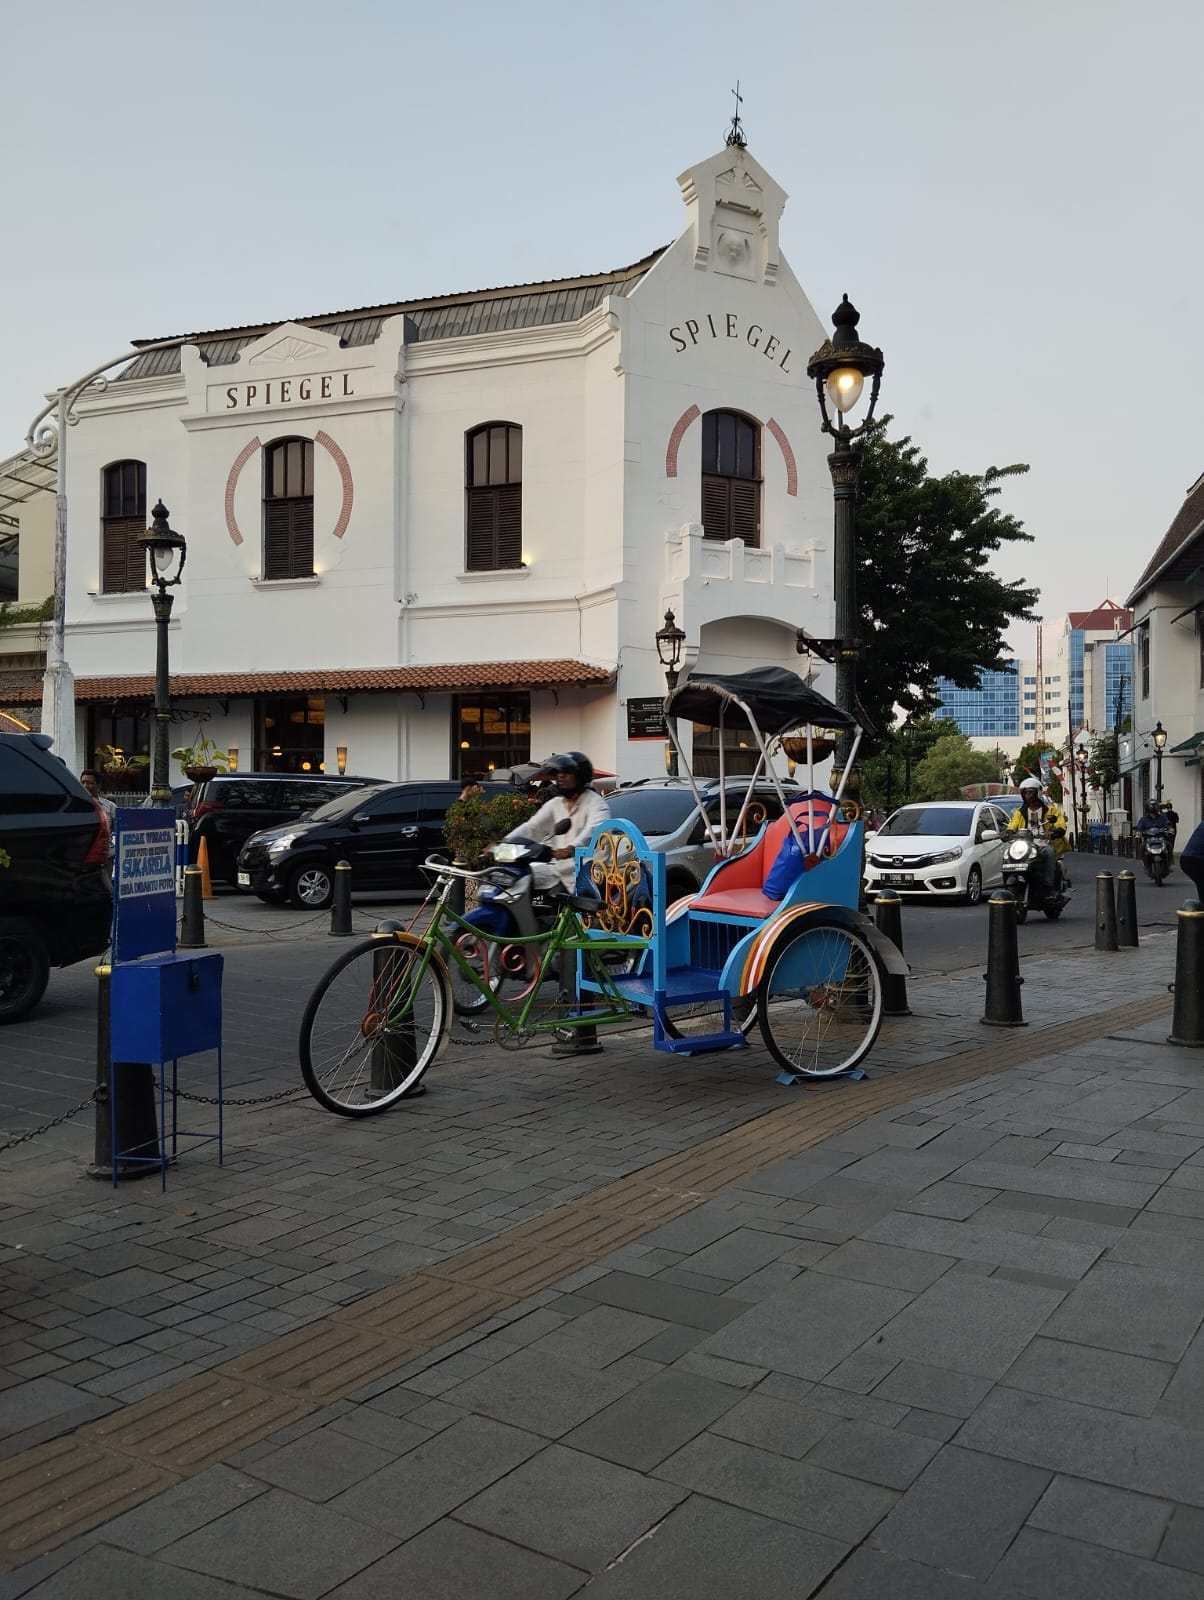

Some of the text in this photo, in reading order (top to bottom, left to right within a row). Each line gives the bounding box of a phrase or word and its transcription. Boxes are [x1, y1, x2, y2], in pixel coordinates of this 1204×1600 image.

[669, 313, 792, 374] SPIEGEL
[226, 373, 354, 409] SPIEGEL
[123, 855, 171, 879] SUKARELA
[158, 878, 174, 891] FOTO
